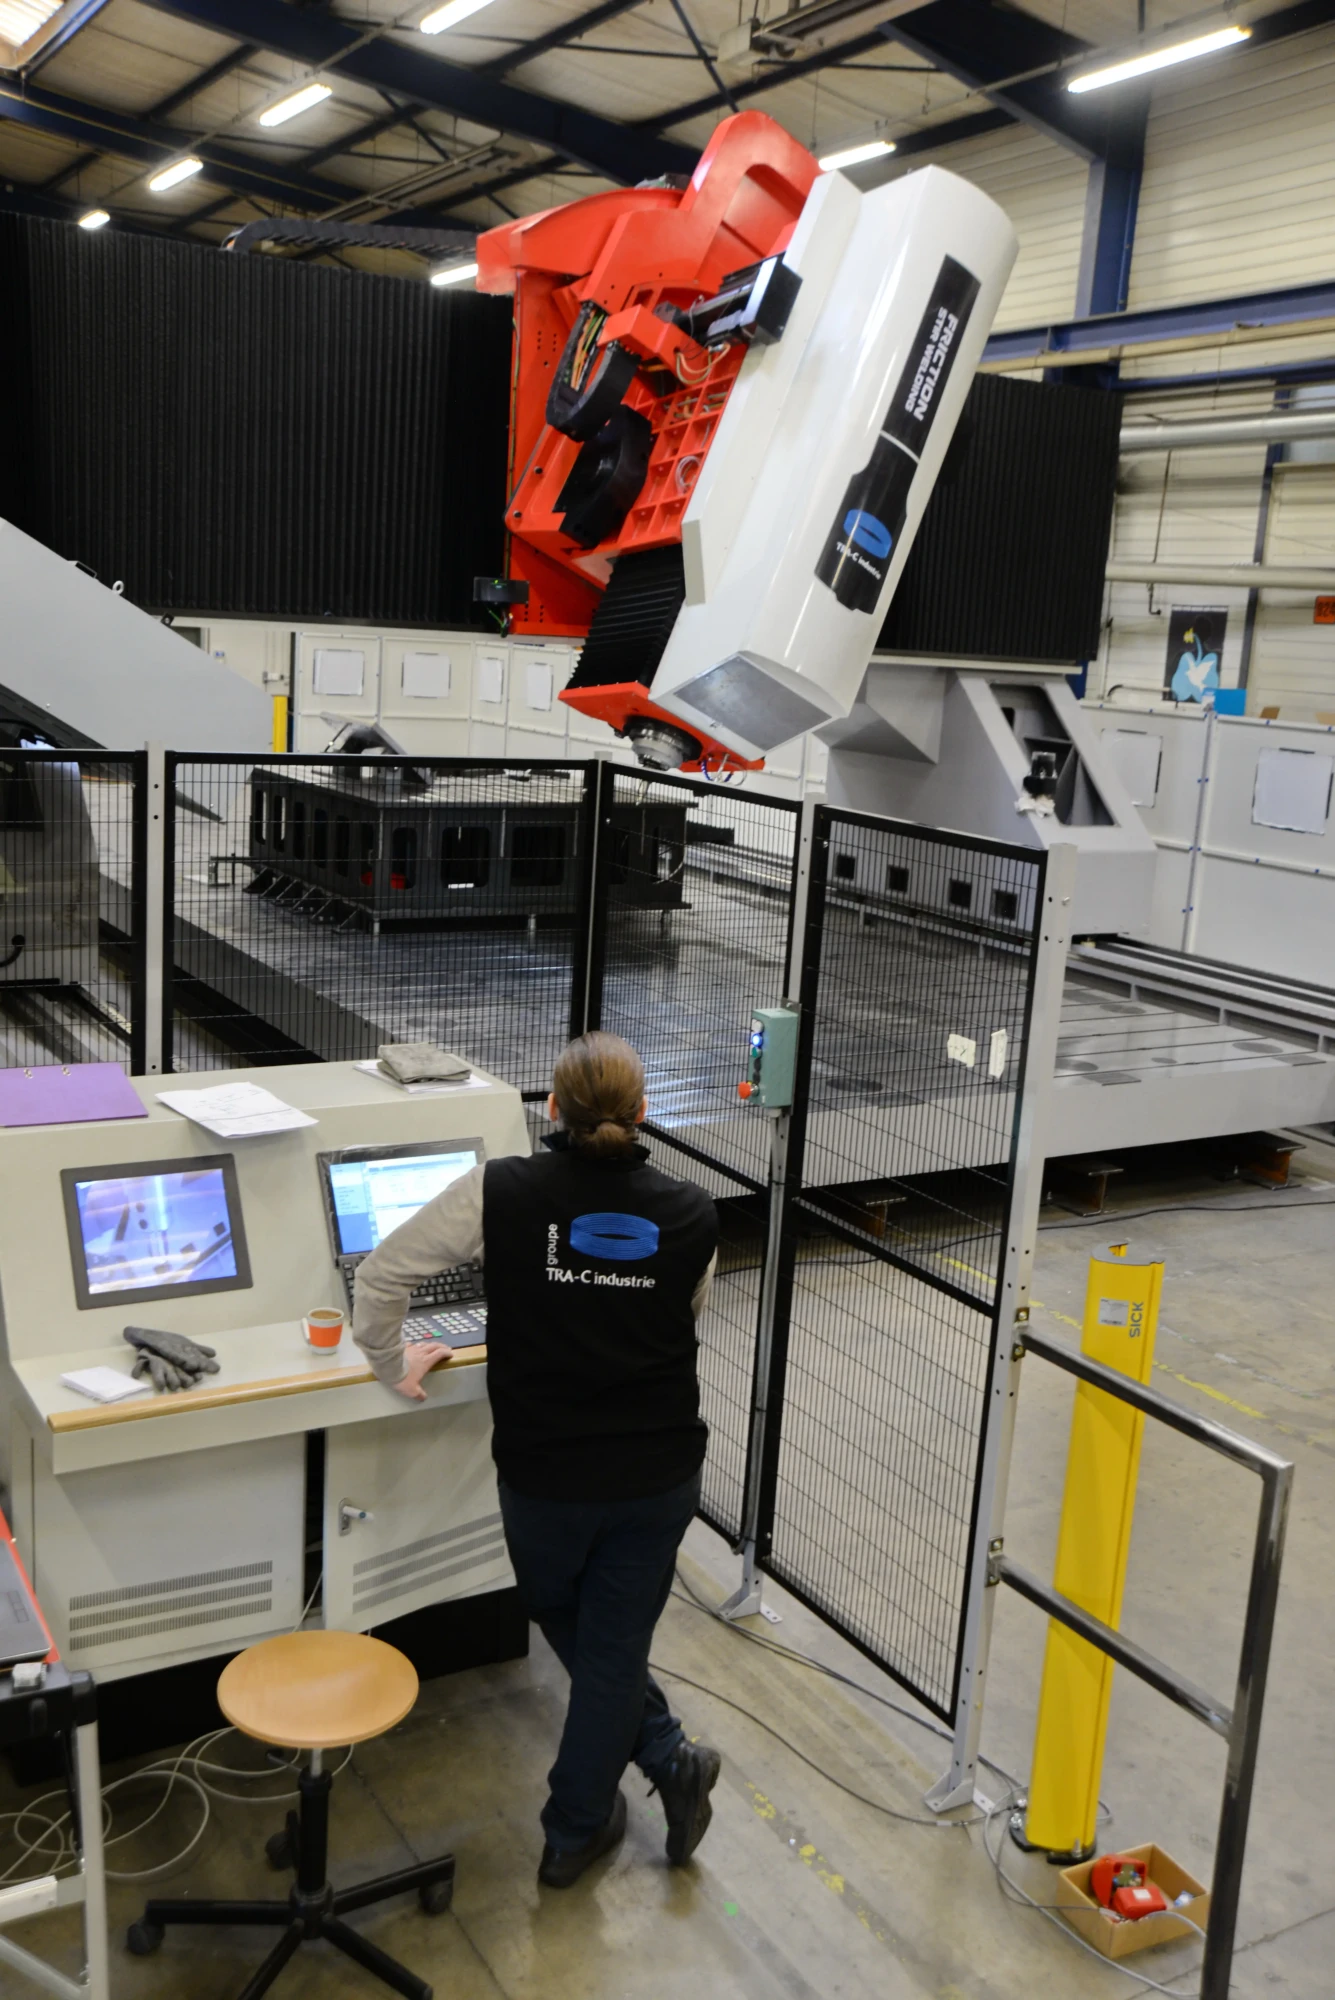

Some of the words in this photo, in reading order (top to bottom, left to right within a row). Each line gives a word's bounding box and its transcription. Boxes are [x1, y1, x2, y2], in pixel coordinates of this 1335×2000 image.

[929, 306, 948, 343] STIR
[904, 343, 936, 413] WELDING
[913, 313, 959, 421] FRICTION
[547, 1223, 559, 1266] groupe
[545, 1267, 592, 1284] TRA-C
[593, 1271, 656, 1288] industrie
[1128, 1301, 1144, 1338] SICK
